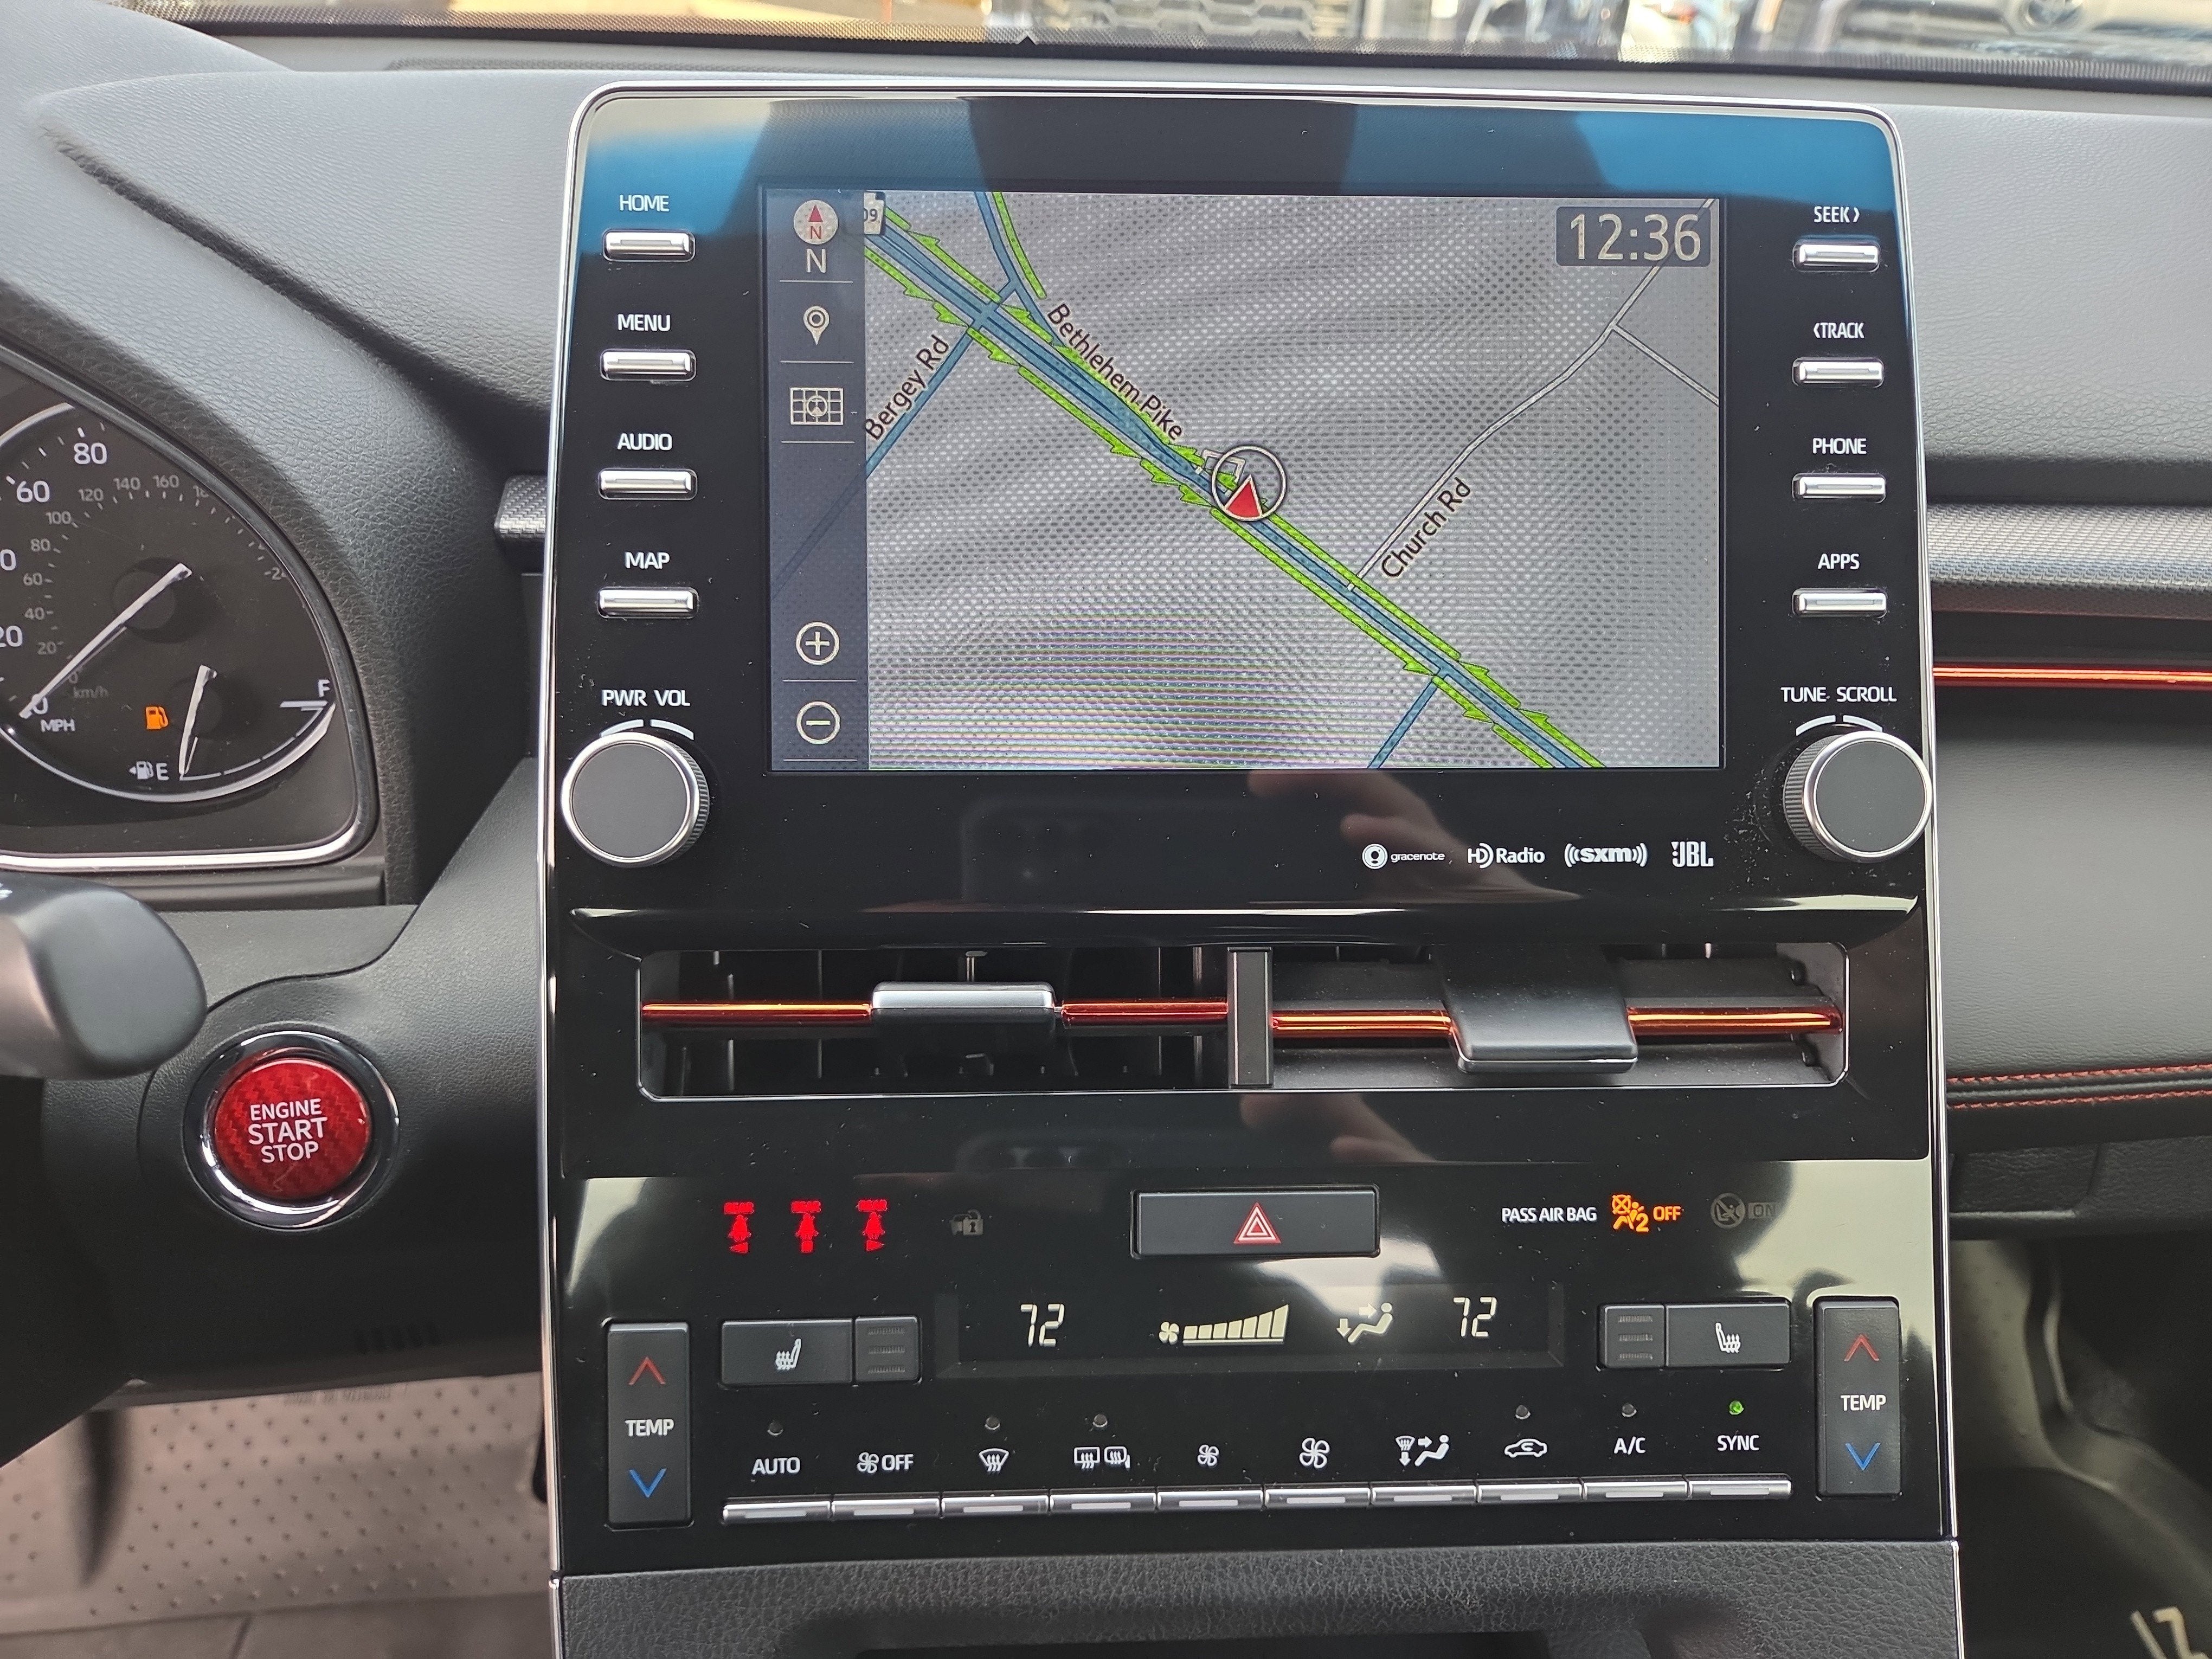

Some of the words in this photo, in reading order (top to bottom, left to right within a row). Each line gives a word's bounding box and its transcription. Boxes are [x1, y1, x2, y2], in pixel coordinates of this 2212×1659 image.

[620, 195, 670, 212] HOME
[1814, 206, 1849, 223] SEEK
[810, 226, 822, 240] N
[1570, 213, 1701, 261] 12:36
[806, 248, 827, 273] N
[617, 314, 671, 331] MENU
[1819, 323, 1864, 339] TRACK
[1047, 303, 1141, 403] Bethlehem
[1140, 394, 1183, 441] Pike
[864, 369, 926, 440] Bergey
[916, 334, 949, 370] Rd
[617, 433, 673, 451] AUDIO
[1812, 438, 1867, 454] PHONE
[74, 442, 107, 465] 80
[113, 477, 140, 490] 140
[152, 475, 179, 488] 160
[16, 481, 50, 503] 60
[79, 488, 104, 502] 120
[46, 511, 71, 525] 100
[1382, 512, 1447, 577] Church
[1438, 477, 1471, 512] Rd
[30, 538, 50, 552] 80
[0, 549, 16, 571] 0
[625, 552, 670, 569] MAP
[1817, 554, 1860, 570] APPS
[23, 573, 43, 586] 60
[24, 607, 45, 620] 40
[37, 641, 57, 655] 20
[318, 679, 330, 697] F
[1780, 686, 1827, 703] TUNE
[1836, 686, 1897, 702] SCROLL
[601, 690, 647, 706] PWR
[654, 690, 691, 706] VOL
[40, 718, 75, 732] MPH
[156, 763, 169, 781] E
[1391, 852, 1445, 863] gracenote
[1467, 843, 1494, 869] HD
[1496, 847, 1546, 864] Radio
[1671, 841, 1714, 867] JBL
[250, 1098, 323, 1121] ENGINE
[248, 1117, 328, 1144] START
[261, 1141, 319, 1163] STOP
[1502, 1207, 1538, 1223] PASS
[1539, 1207, 1565, 1222] AIR
[1566, 1207, 1597, 1221] BAG
[1653, 1206, 1681, 1220] OFF
[1020, 1303, 1065, 1347] 72
[1453, 1297, 1497, 1337] 72
[1840, 1394, 1886, 1411] TEMP
[625, 1419, 674, 1436] TEMP
[1613, 1436, 1646, 1455] A/C
[1717, 1435, 1760, 1451] SYNC
[751, 1457, 801, 1475] AUTO
[882, 1454, 914, 1471] OFF
